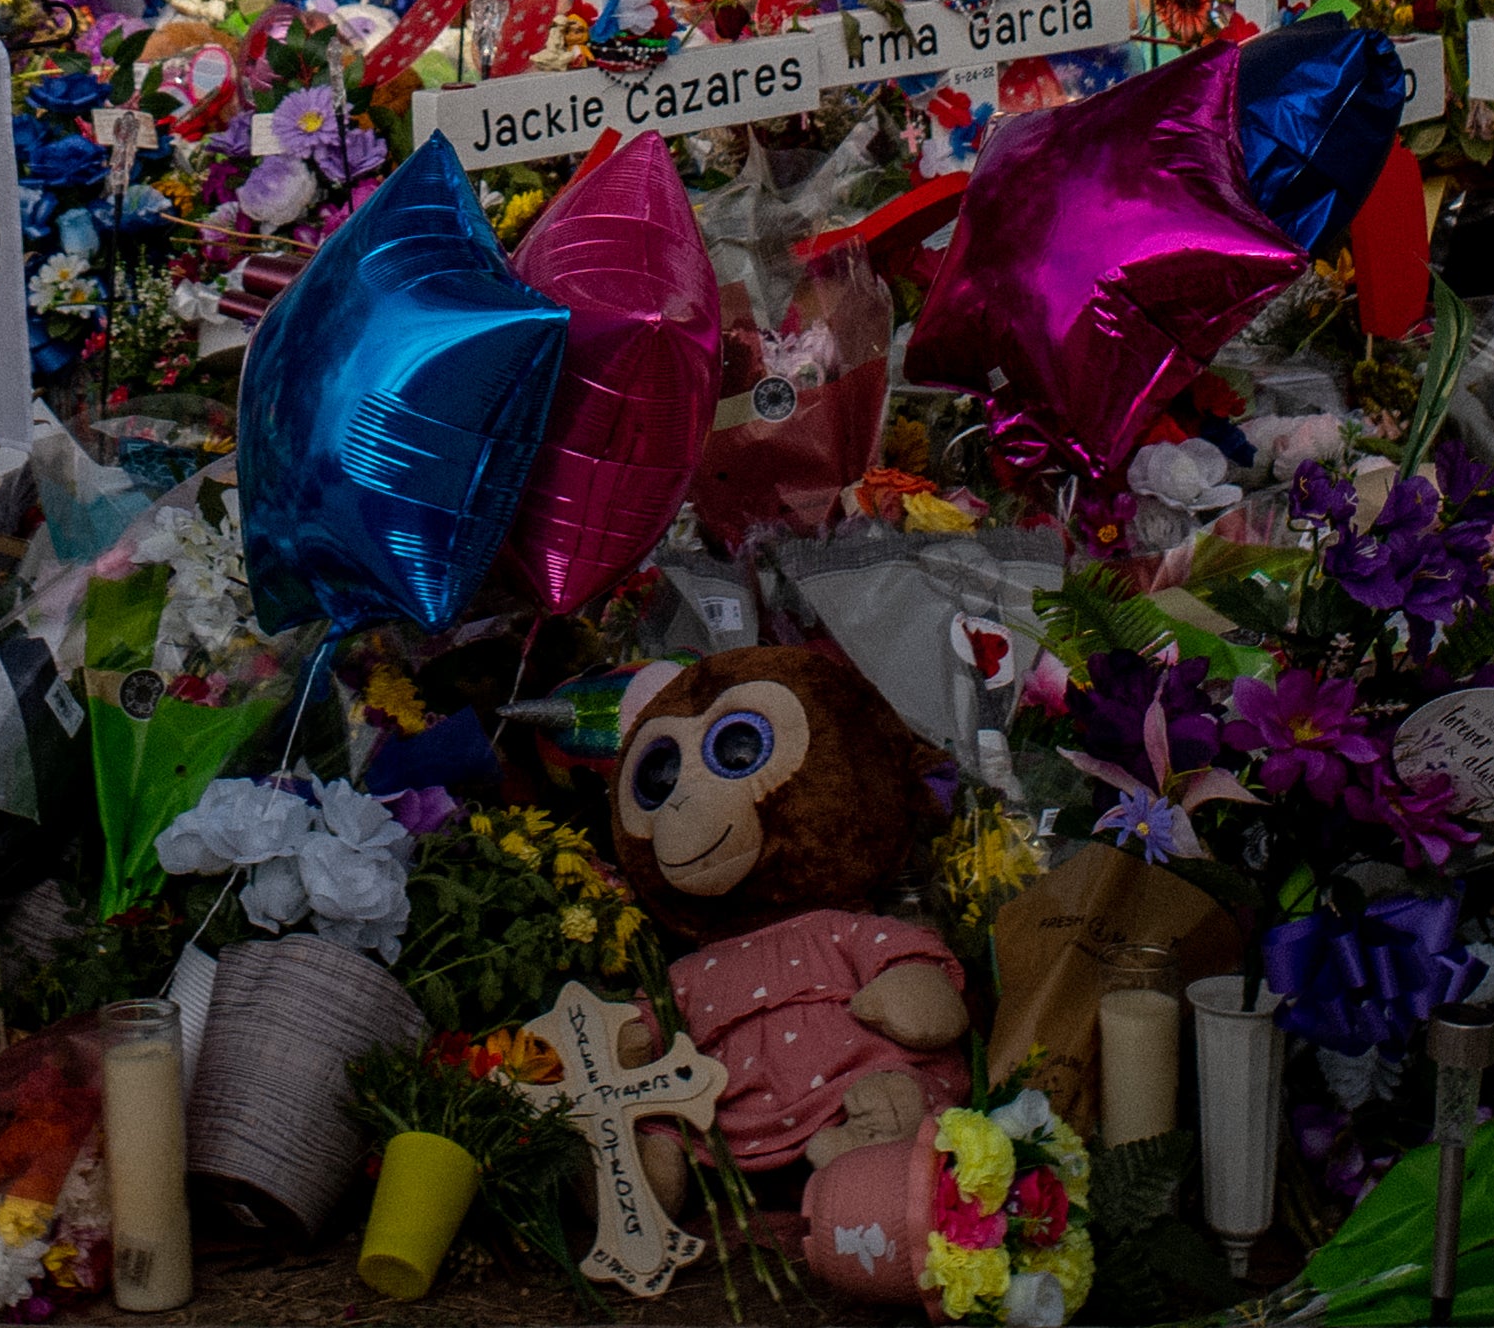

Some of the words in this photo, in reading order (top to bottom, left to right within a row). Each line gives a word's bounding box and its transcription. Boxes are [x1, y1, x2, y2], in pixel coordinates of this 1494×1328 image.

[954, 66, 995, 86] 5-24-22
[473, 95, 604, 152] Jackie
[626, 57, 803, 124] Cazares
[1439, 704, 1493, 750] forever
[1039, 914, 1087, 930] FRESH
[593, 1072, 672, 1105] Prayers
[600, 1118, 644, 1238] STRONG
